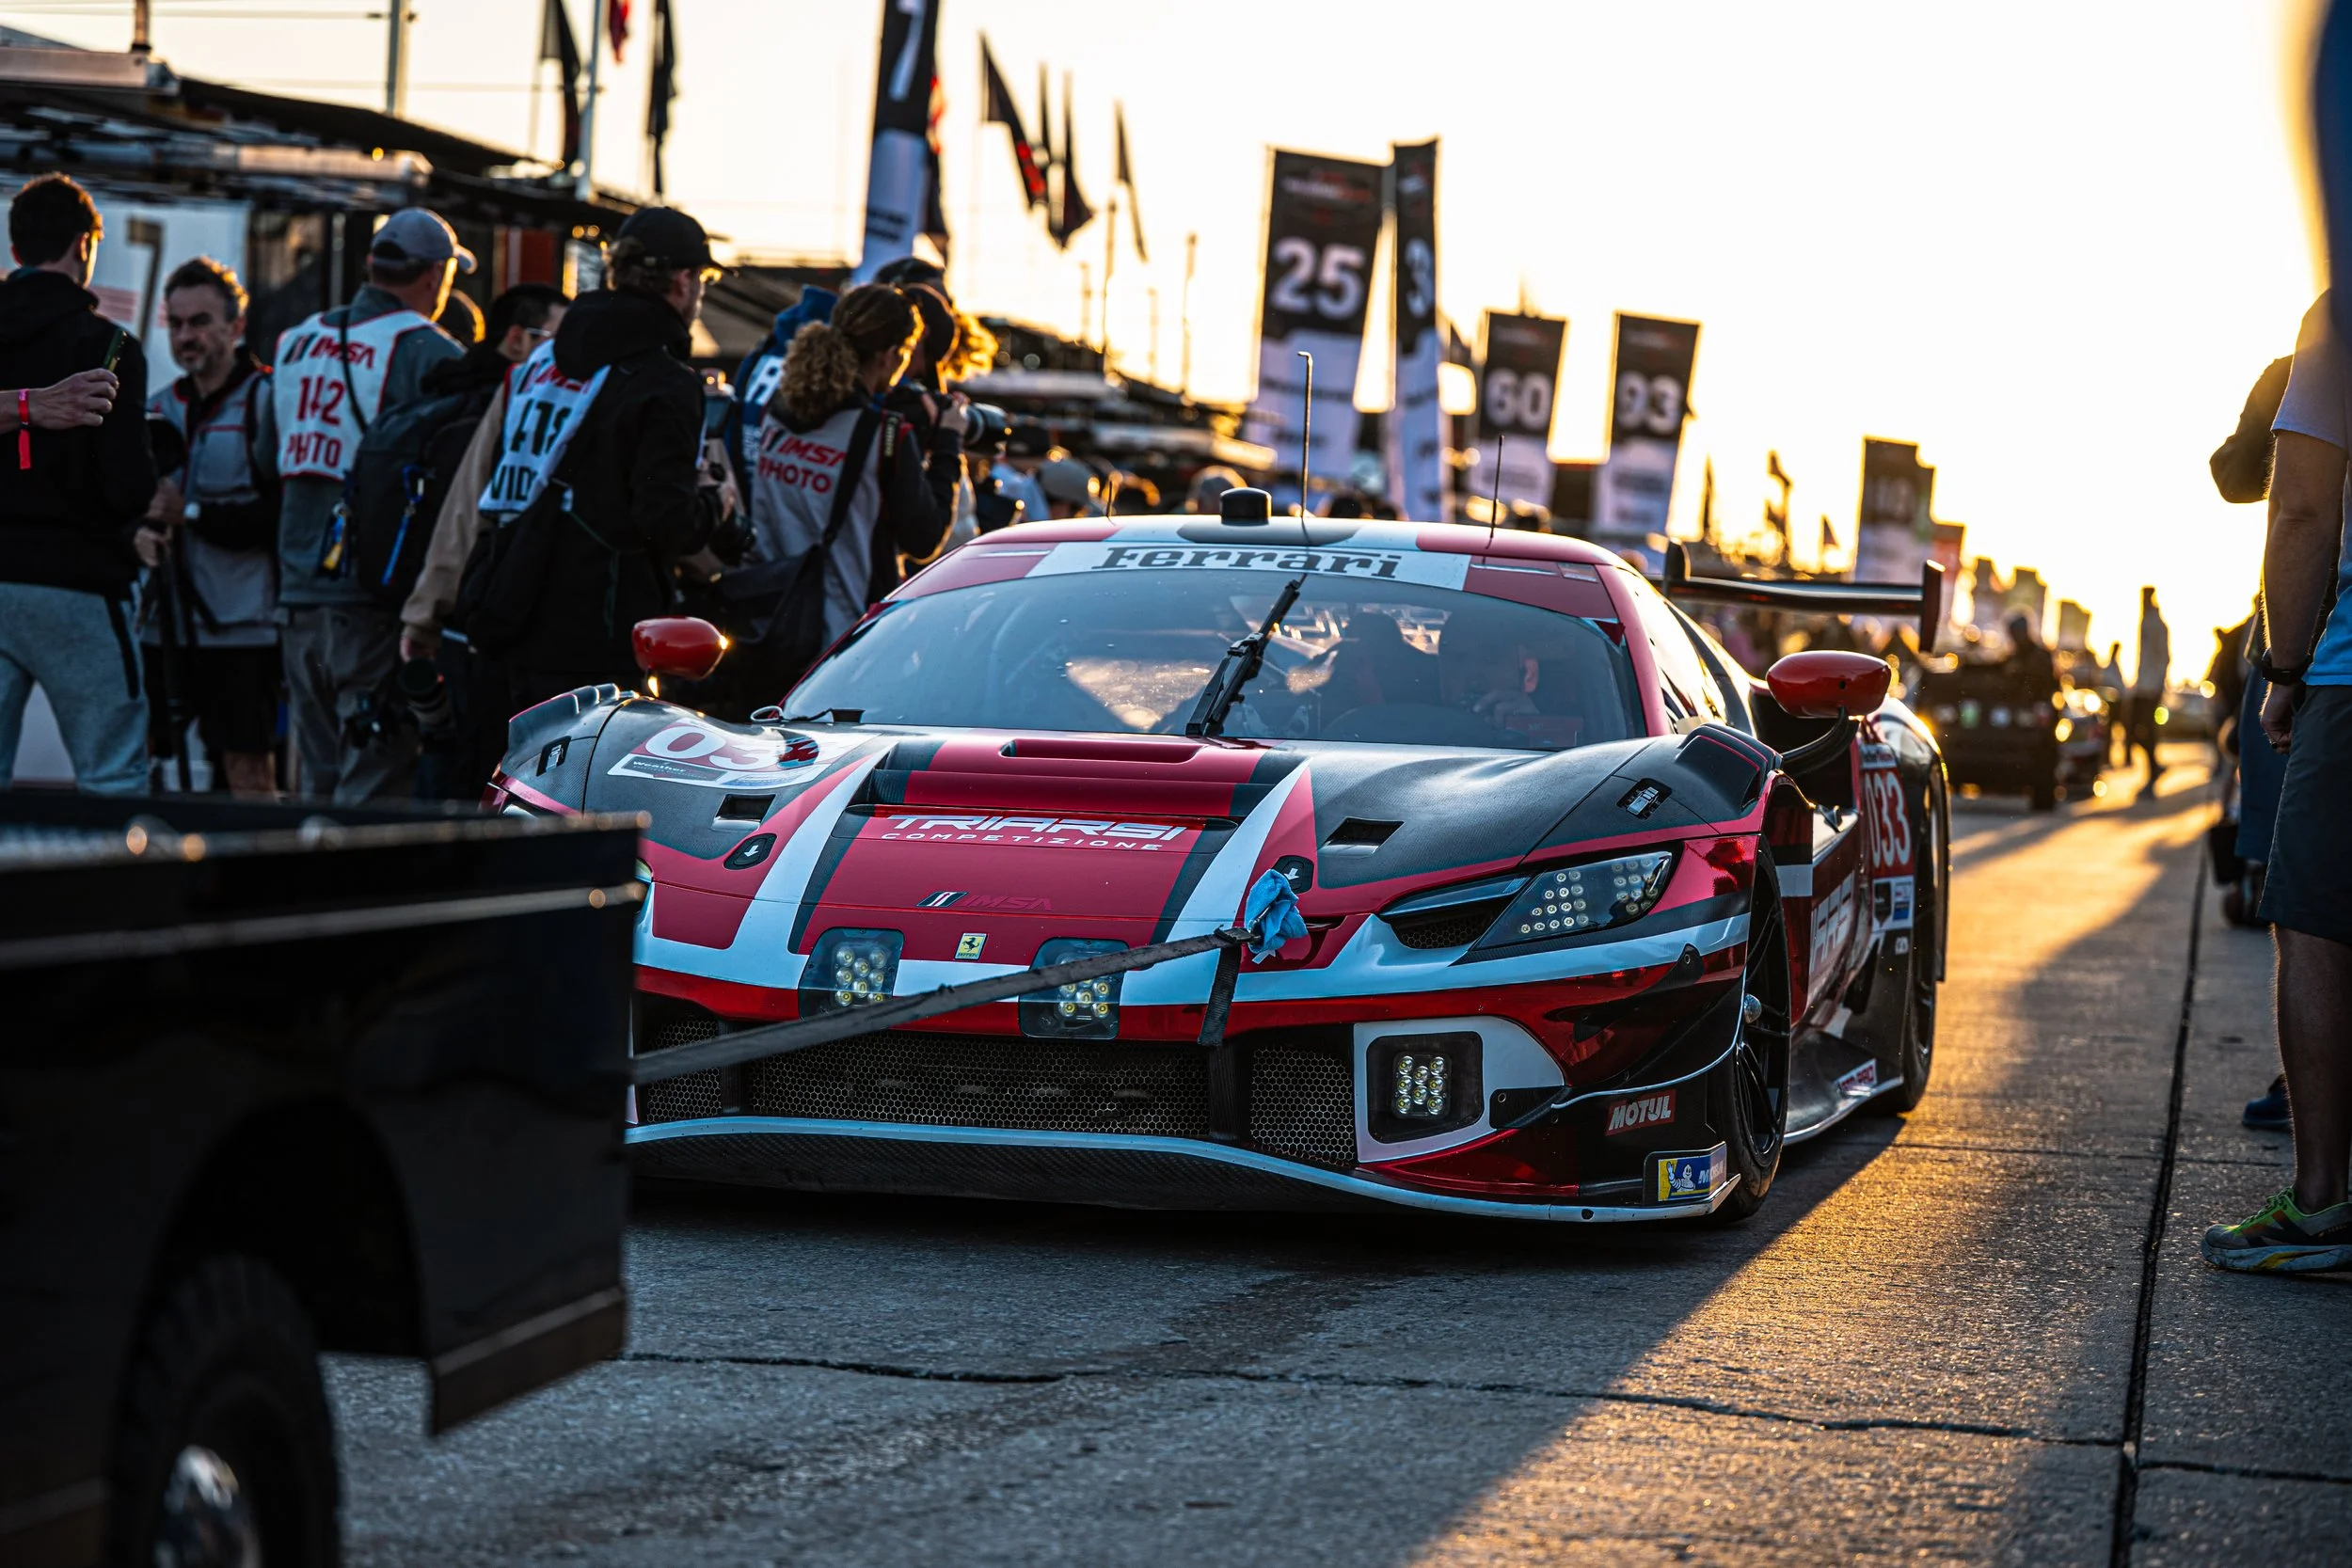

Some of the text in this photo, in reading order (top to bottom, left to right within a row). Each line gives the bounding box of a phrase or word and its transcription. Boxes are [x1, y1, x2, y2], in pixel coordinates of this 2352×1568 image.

[1271, 237, 1364, 320] 25
[1091, 546, 1402, 579] Ferrari
[887, 815, 1187, 841] TRIARSI
[1865, 771, 1911, 868] 033
[881, 832, 1163, 851] COMPETIZIONE
[957, 895, 1053, 911] IMSA
[1608, 1095, 1672, 1131] MOTUL
